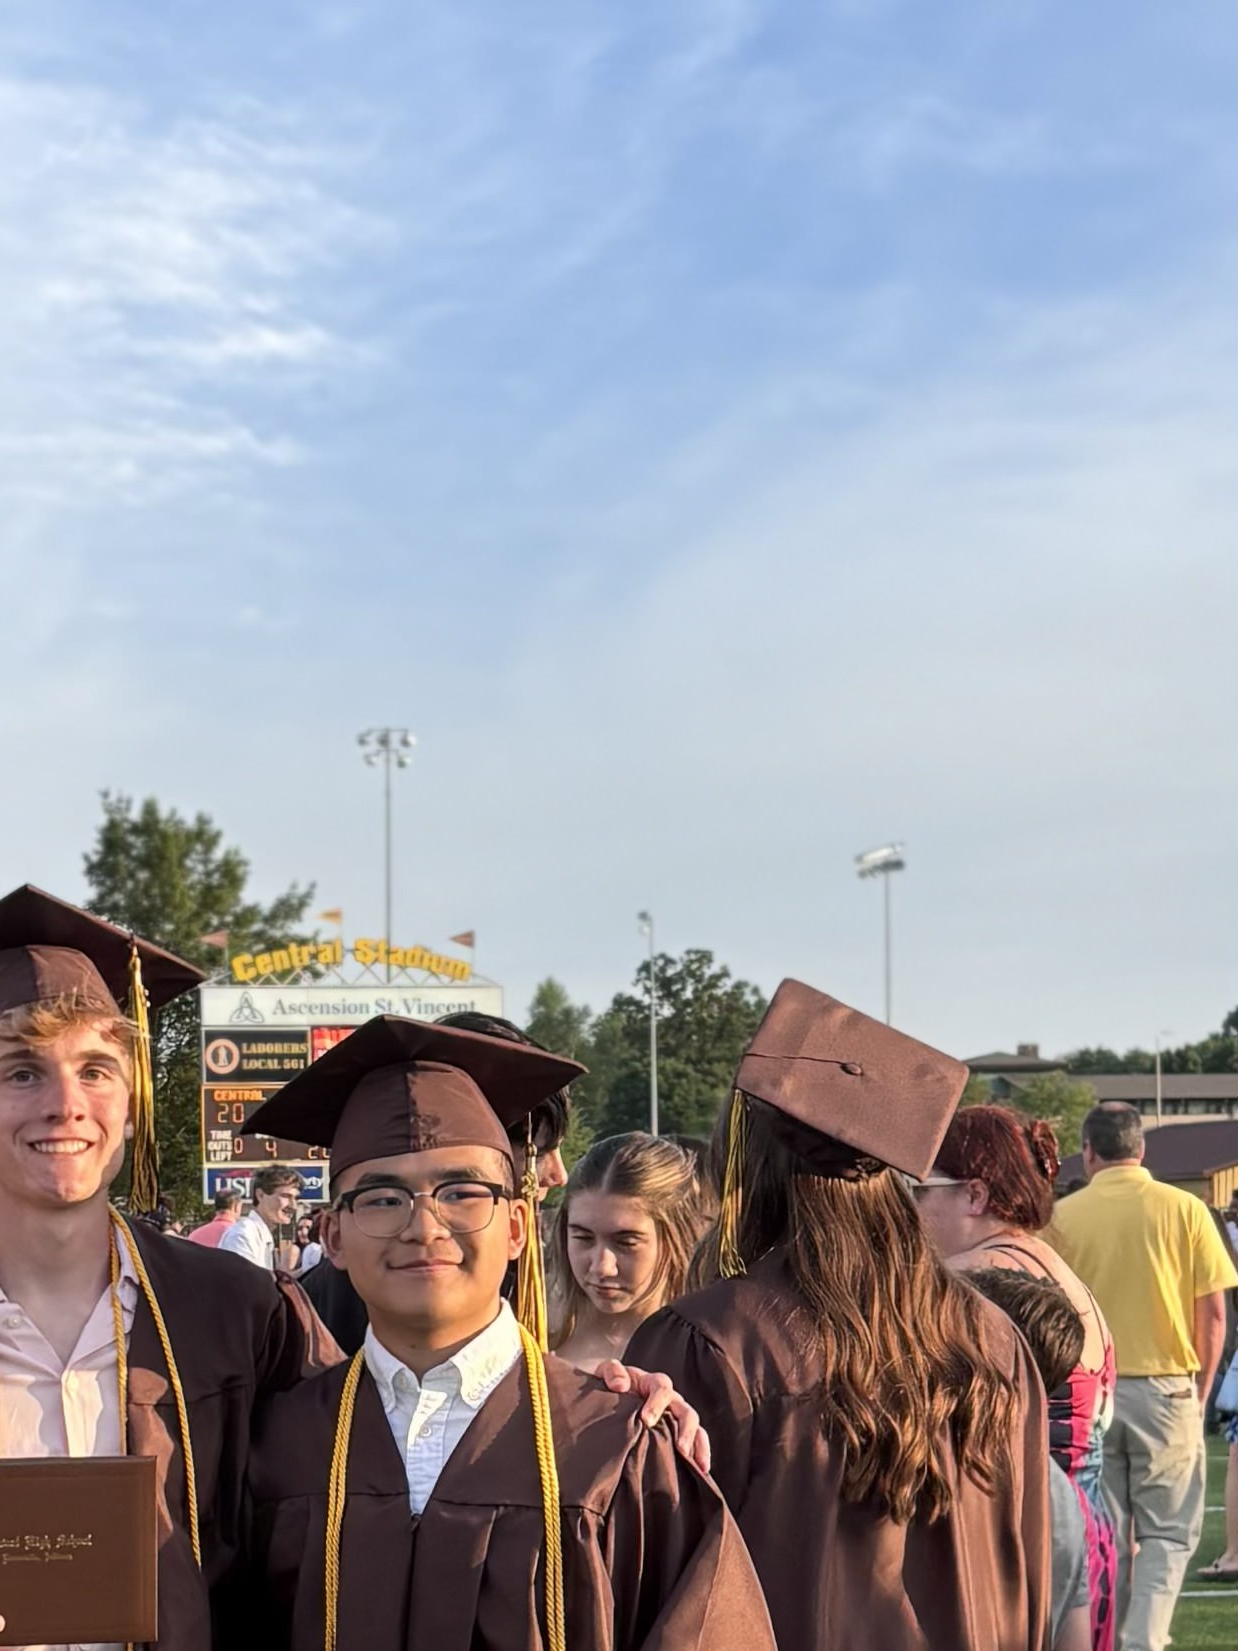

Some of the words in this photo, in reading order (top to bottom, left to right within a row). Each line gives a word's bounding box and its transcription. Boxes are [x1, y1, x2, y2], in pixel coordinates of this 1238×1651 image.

[231, 939, 343, 982] Central
[352, 937, 471, 982] Stadium
[272, 998, 370, 1016] Ascension
[374, 998, 399, 1016] St.
[402, 998, 476, 1016] Vincent
[242, 1058, 282, 1070] LOCAL
[283, 1058, 305, 1070] 561
[214, 1090, 267, 1101] CENTRAL
[218, 1103, 244, 1123] 20
[210, 1130, 232, 1140] TIME
[208, 1141, 233, 1151] OUTS
[234, 1137, 243, 1154] 0
[210, 1151, 233, 1161] LEFT
[215, 1177, 252, 1198] USI
